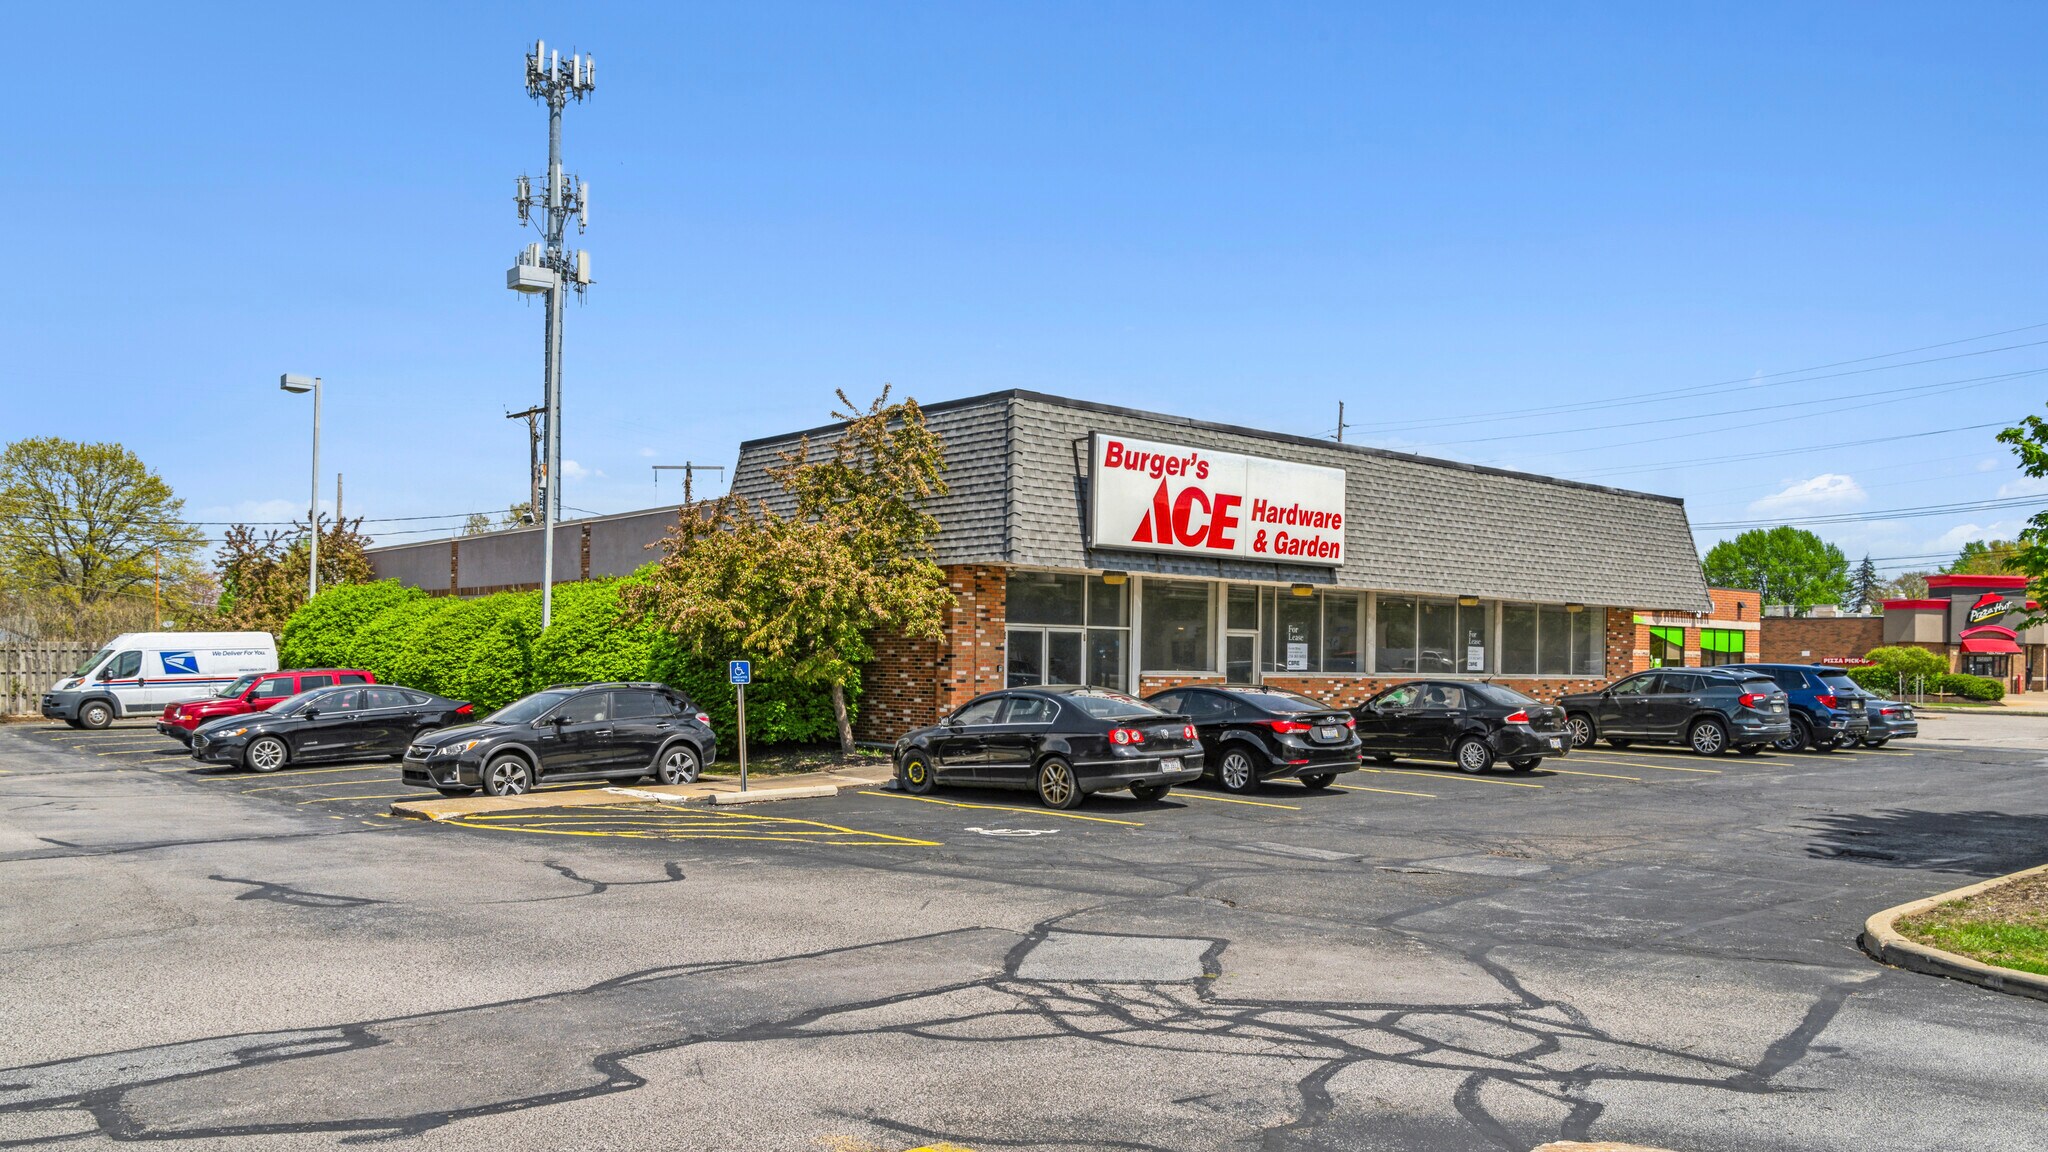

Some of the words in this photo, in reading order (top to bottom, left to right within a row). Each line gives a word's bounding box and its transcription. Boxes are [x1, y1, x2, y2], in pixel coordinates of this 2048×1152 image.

[1104, 440, 1210, 480] Burger's
[1131, 475, 1242, 550] ACE
[1251, 498, 1342, 530] Hardware
[1253, 529, 1267, 553] &
[1274, 531, 1340, 559] Garden
[1994, 601, 2013, 612] Hut
[1288, 624, 1299, 633] For
[1288, 632, 1304, 641] Lease
[1468, 630, 1477, 638] For
